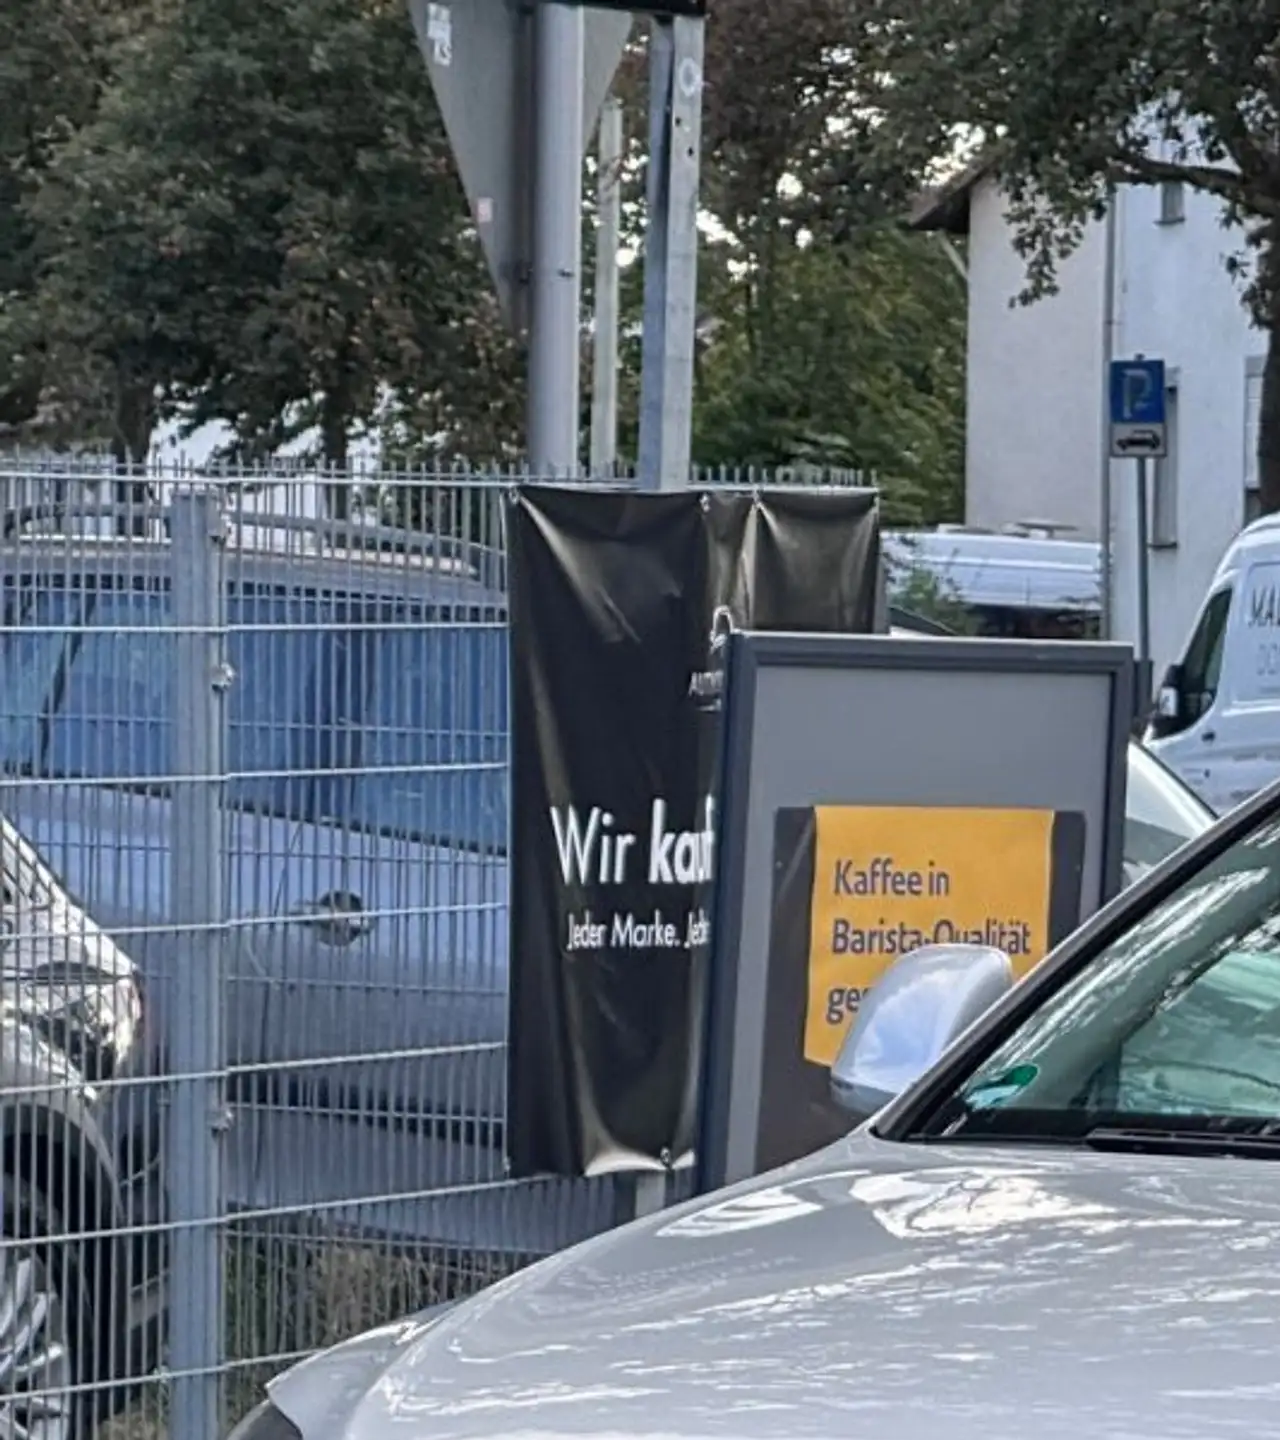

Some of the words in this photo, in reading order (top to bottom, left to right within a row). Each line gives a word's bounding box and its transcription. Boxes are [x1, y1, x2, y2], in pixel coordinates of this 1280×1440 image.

[1122, 368, 1153, 419] P
[550, 803, 636, 885] Wir
[833, 857, 923, 897] Kaffee
[928, 859, 950, 897] in
[566, 911, 607, 950] Jeder
[610, 908, 681, 948] Marke.
